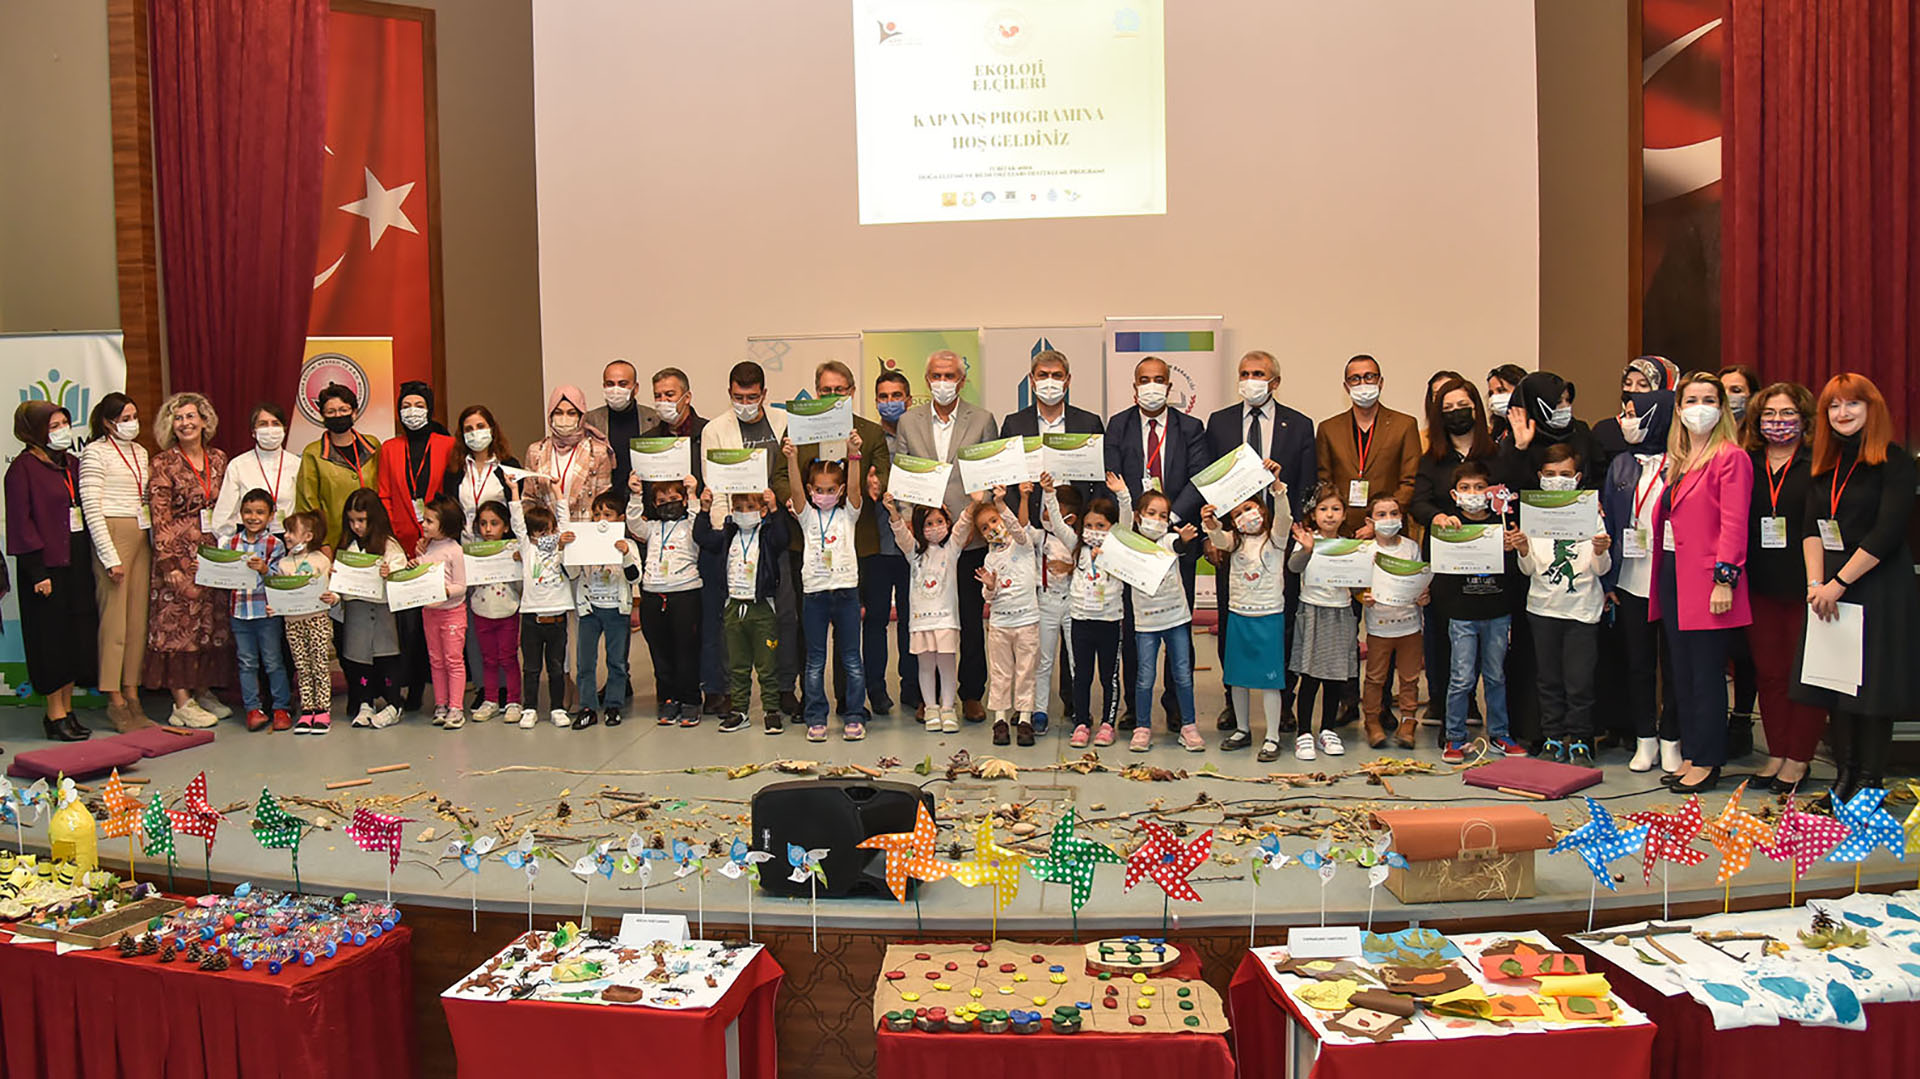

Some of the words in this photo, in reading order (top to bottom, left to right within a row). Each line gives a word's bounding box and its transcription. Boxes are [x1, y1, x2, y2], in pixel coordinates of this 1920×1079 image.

[975, 59, 1044, 76] EKOLOJİ
[973, 74, 1046, 92] ELÇİLERİ
[914, 113, 987, 128] KAPANIŞ
[990, 107, 1104, 124] PROGRAMINA
[952, 135, 987, 152] HOŞ
[990, 129, 1070, 148] GELDİNİZ
